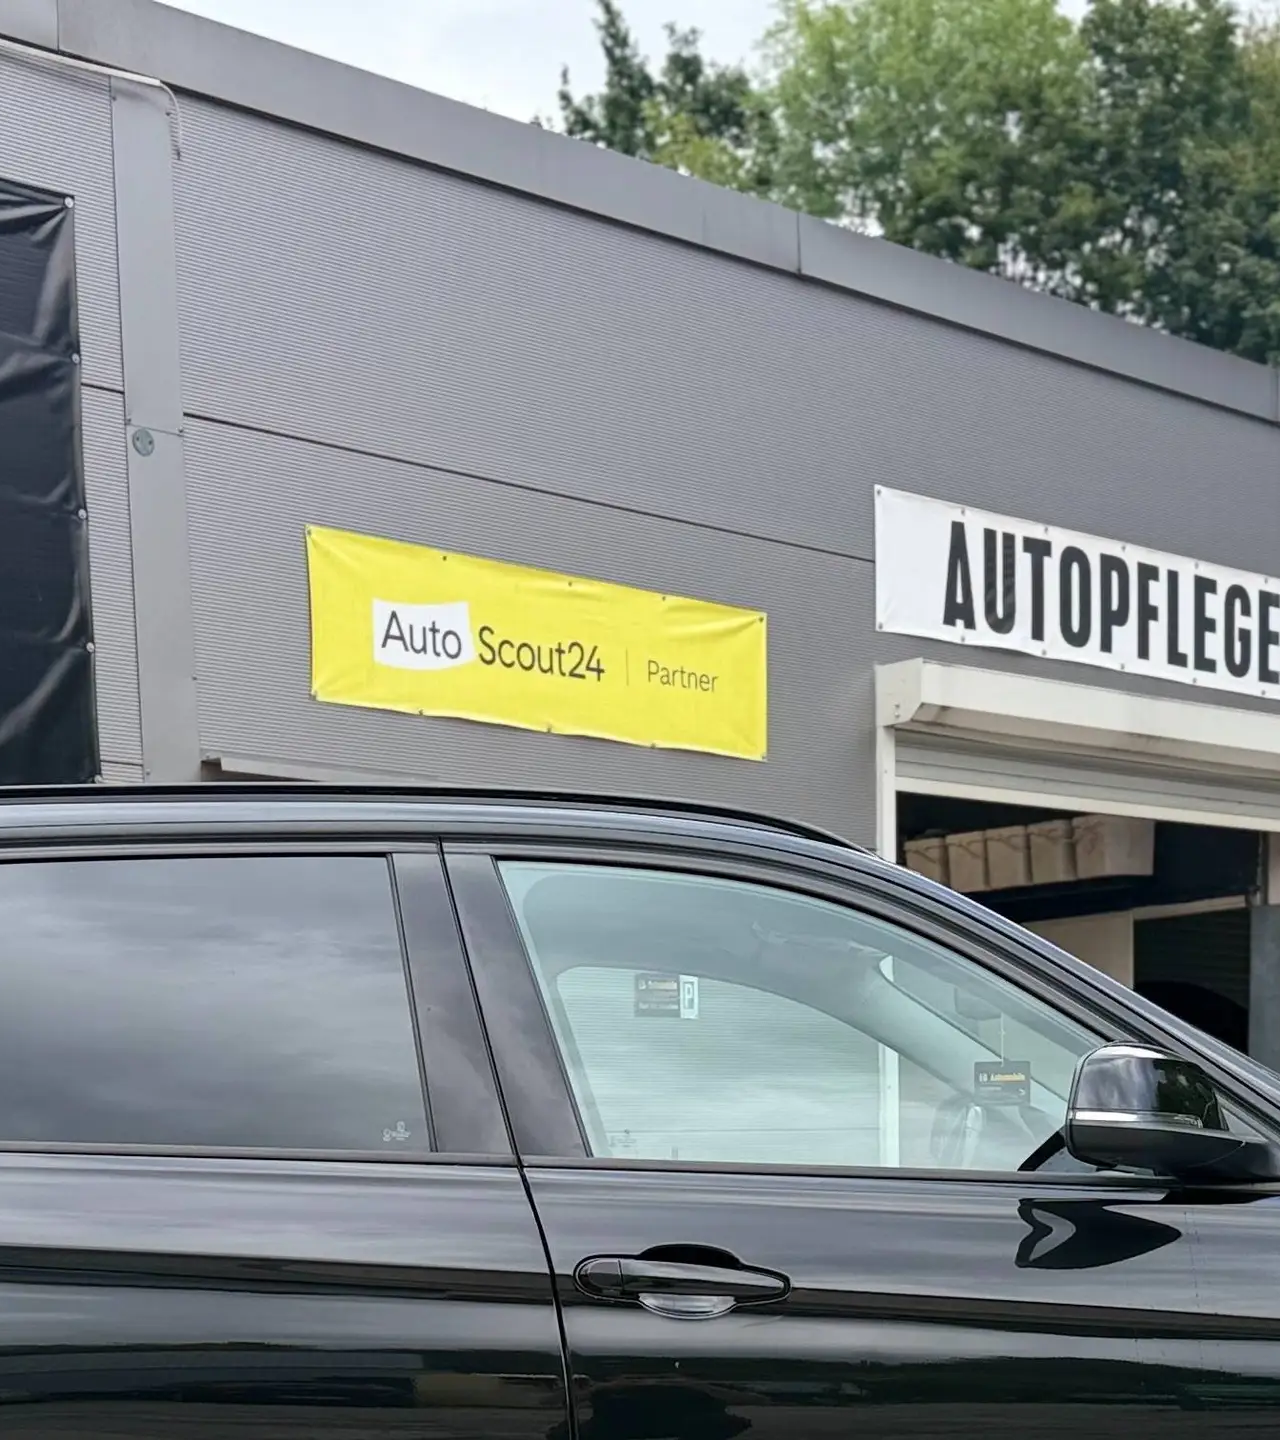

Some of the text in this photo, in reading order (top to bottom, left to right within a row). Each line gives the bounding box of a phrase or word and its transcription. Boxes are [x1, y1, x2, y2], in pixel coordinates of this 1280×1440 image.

[381, 610, 719, 692] Auto Scout24 Partner
[943, 521, 1280, 685] AUTOPFLEGE
